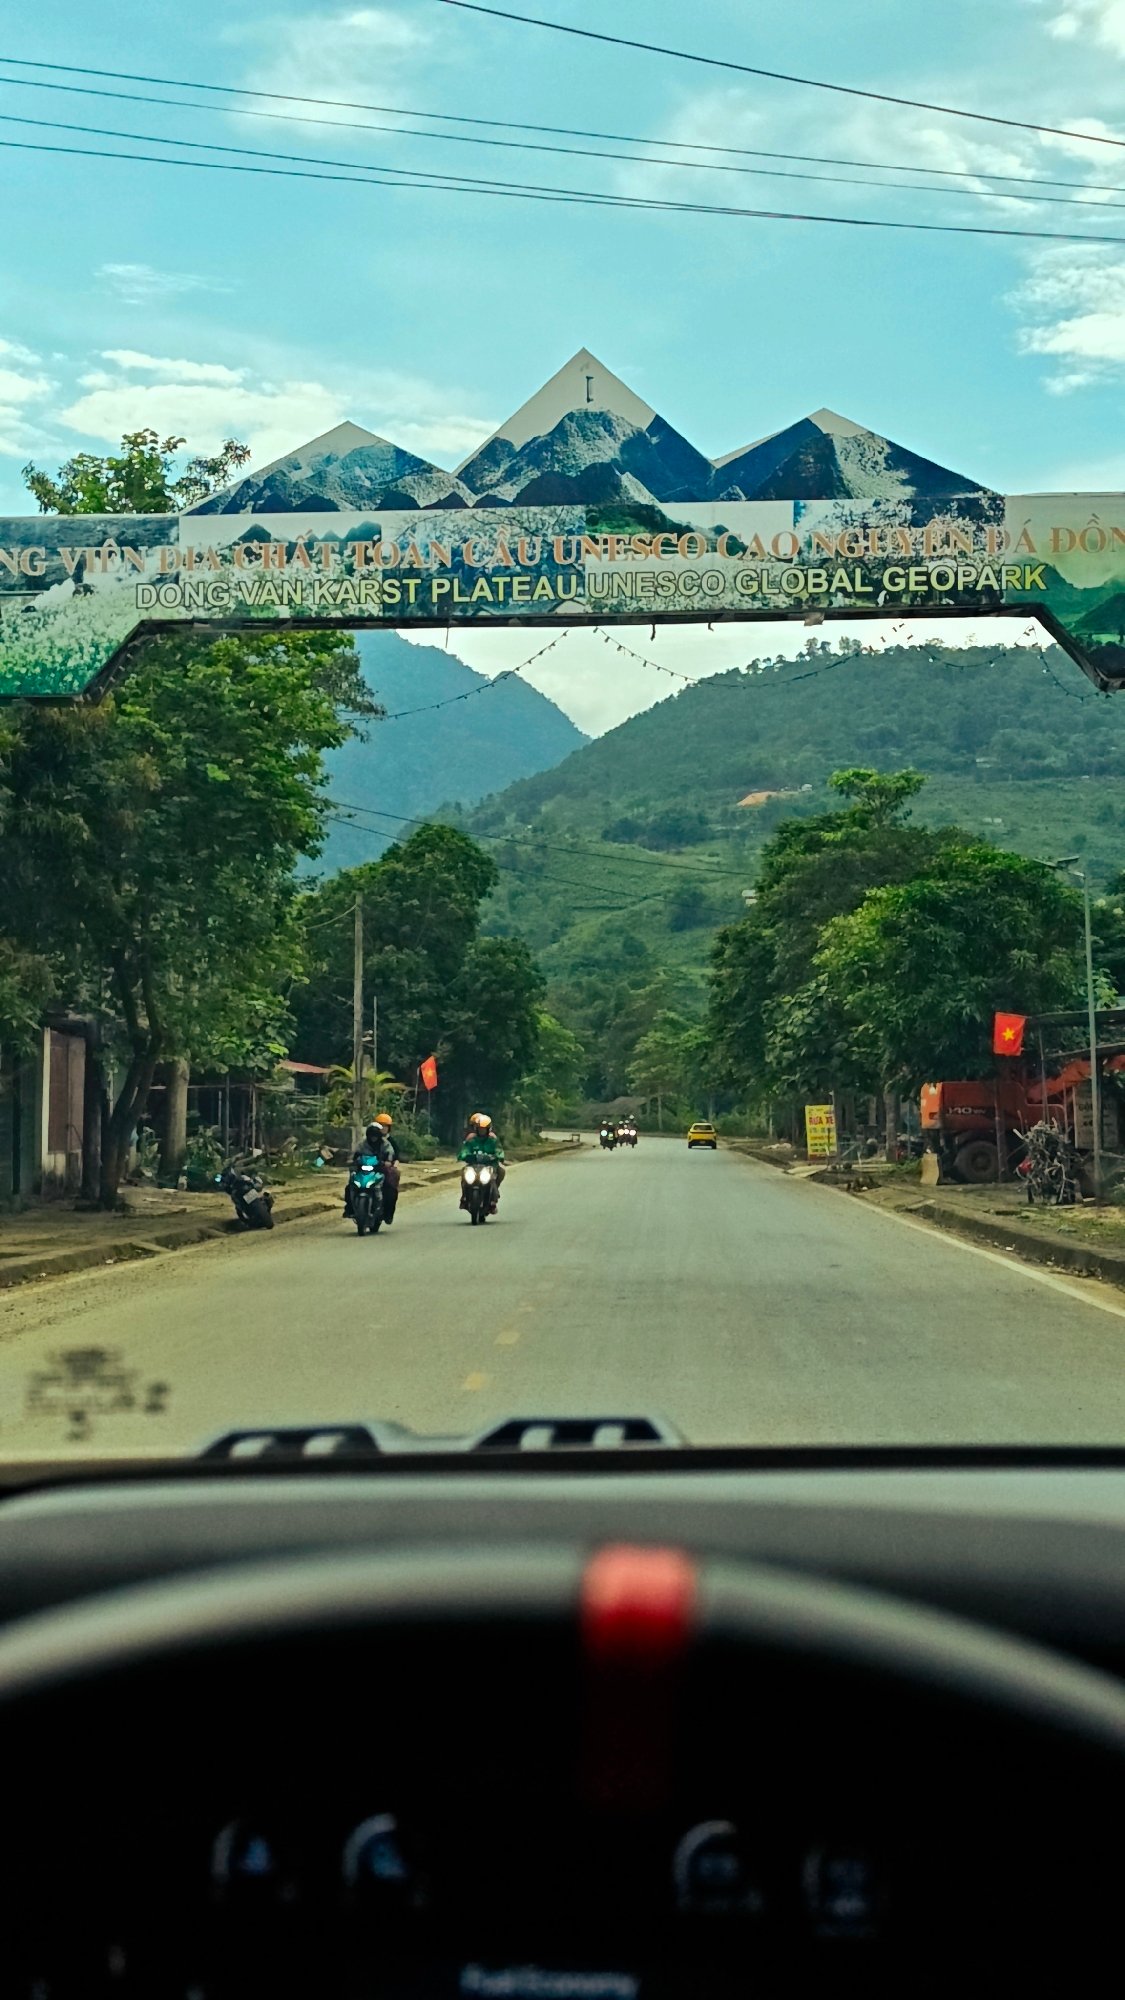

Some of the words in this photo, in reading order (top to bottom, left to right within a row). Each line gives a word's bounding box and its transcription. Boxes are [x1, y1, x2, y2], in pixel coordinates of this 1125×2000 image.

[57, 538, 149, 576] VIÊN
[235, 529, 339, 572] CHẤT
[347, 530, 453, 568] TOÀN
[461, 524, 543, 567] CẦU
[552, 532, 708, 565] UNESCO
[716, 531, 801, 560] CAO
[811, 518, 974, 558] NGUYÊN
[136, 580, 231, 609] DONG
[239, 579, 303, 606] VAN
[313, 577, 422, 605] KARST
[430, 574, 578, 604] PLATEAU
[587, 570, 726, 599] UNESCO
[735, 567, 873, 595] GLOBAL
[882, 562, 1050, 592] GEOPARK
